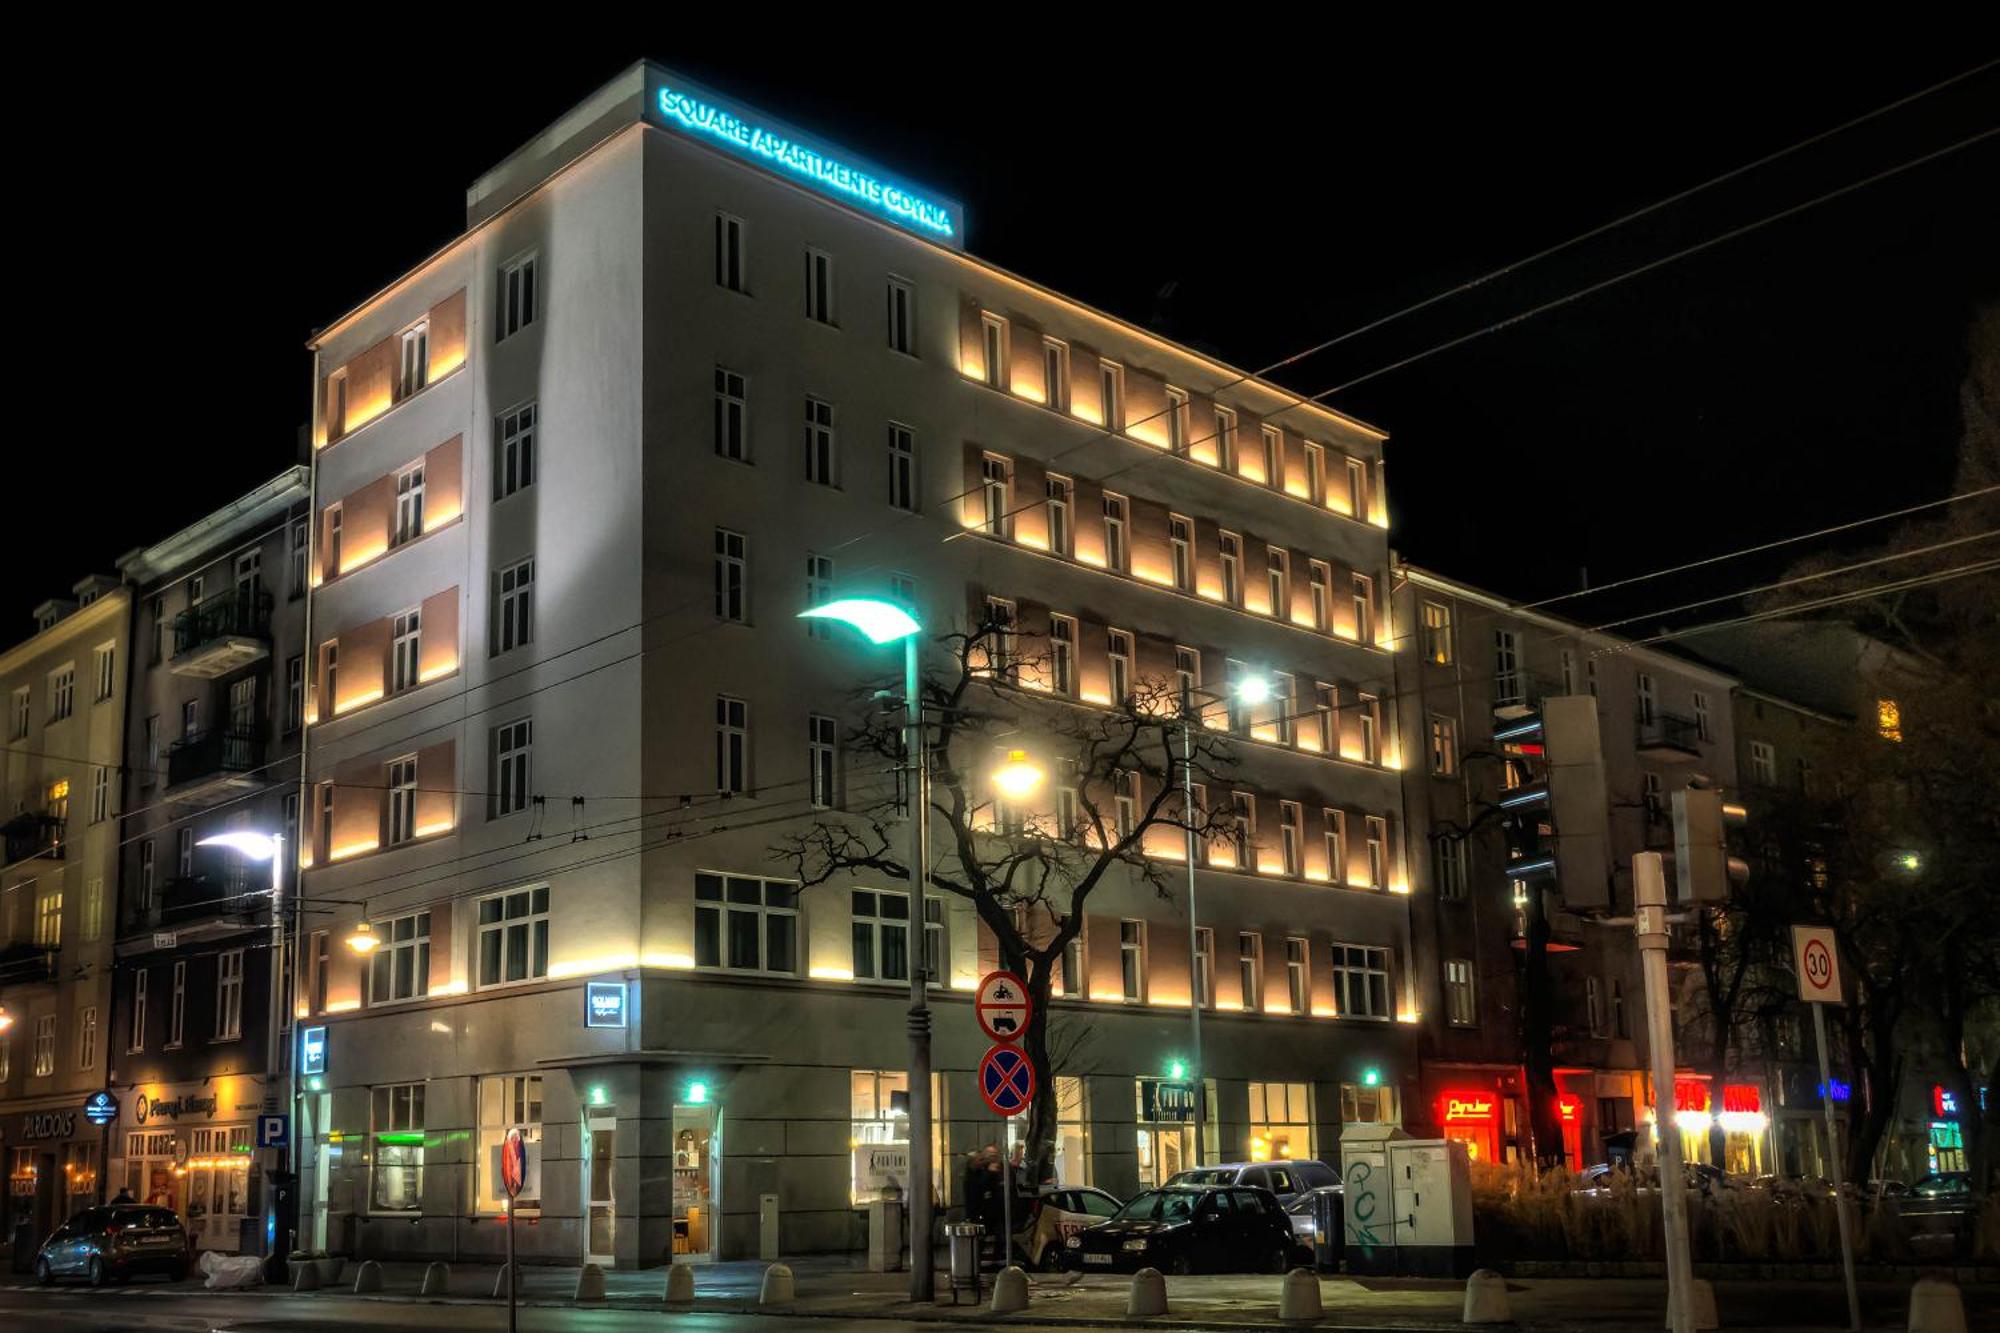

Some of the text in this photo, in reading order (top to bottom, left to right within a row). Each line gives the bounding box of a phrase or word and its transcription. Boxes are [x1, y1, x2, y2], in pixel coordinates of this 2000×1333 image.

[659, 86, 954, 236] SQUARE APARTMENTS GDYNIA
[1808, 953, 1828, 976] 30
[265, 1118, 283, 1145] P
[279, 1190, 286, 1201] P
